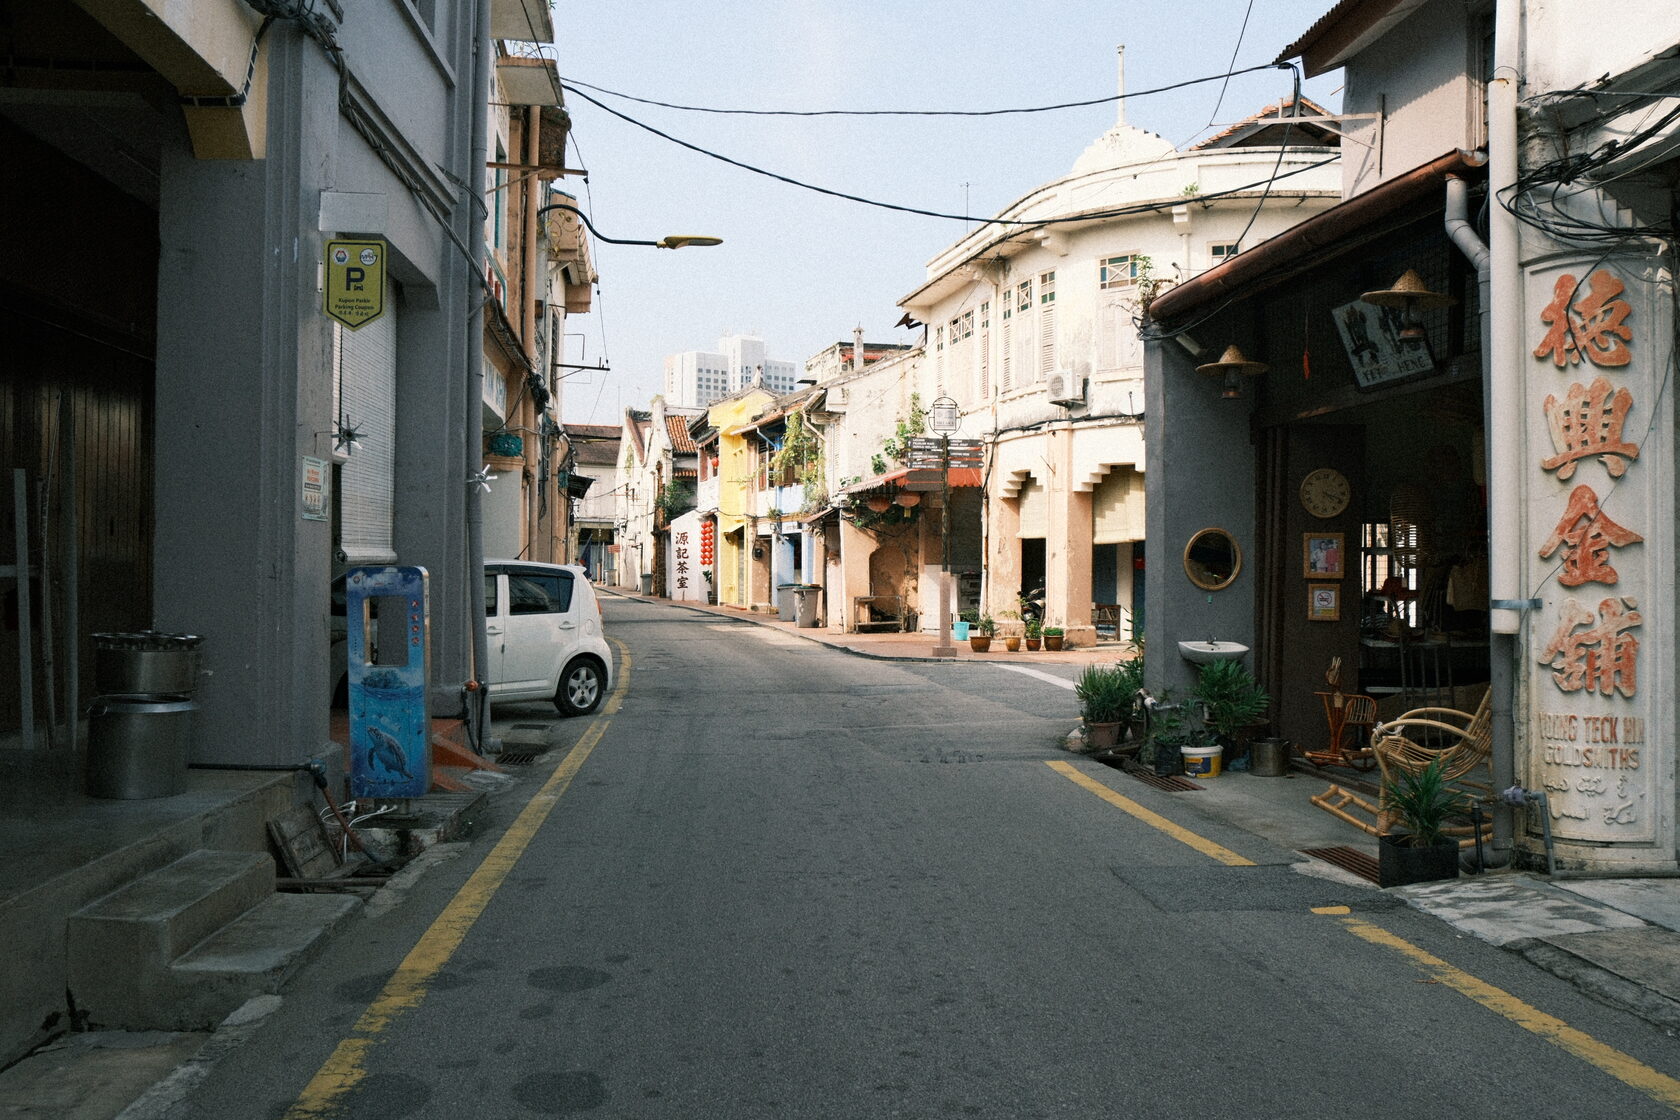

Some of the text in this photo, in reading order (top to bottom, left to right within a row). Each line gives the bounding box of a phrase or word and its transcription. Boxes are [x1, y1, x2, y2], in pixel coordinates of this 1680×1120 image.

[346, 267, 365, 291] P
[675, 531, 689, 589] 源記茶室
[1583, 715, 1618, 743] TECK
[1543, 743, 1640, 770] GOLDSMITHS
